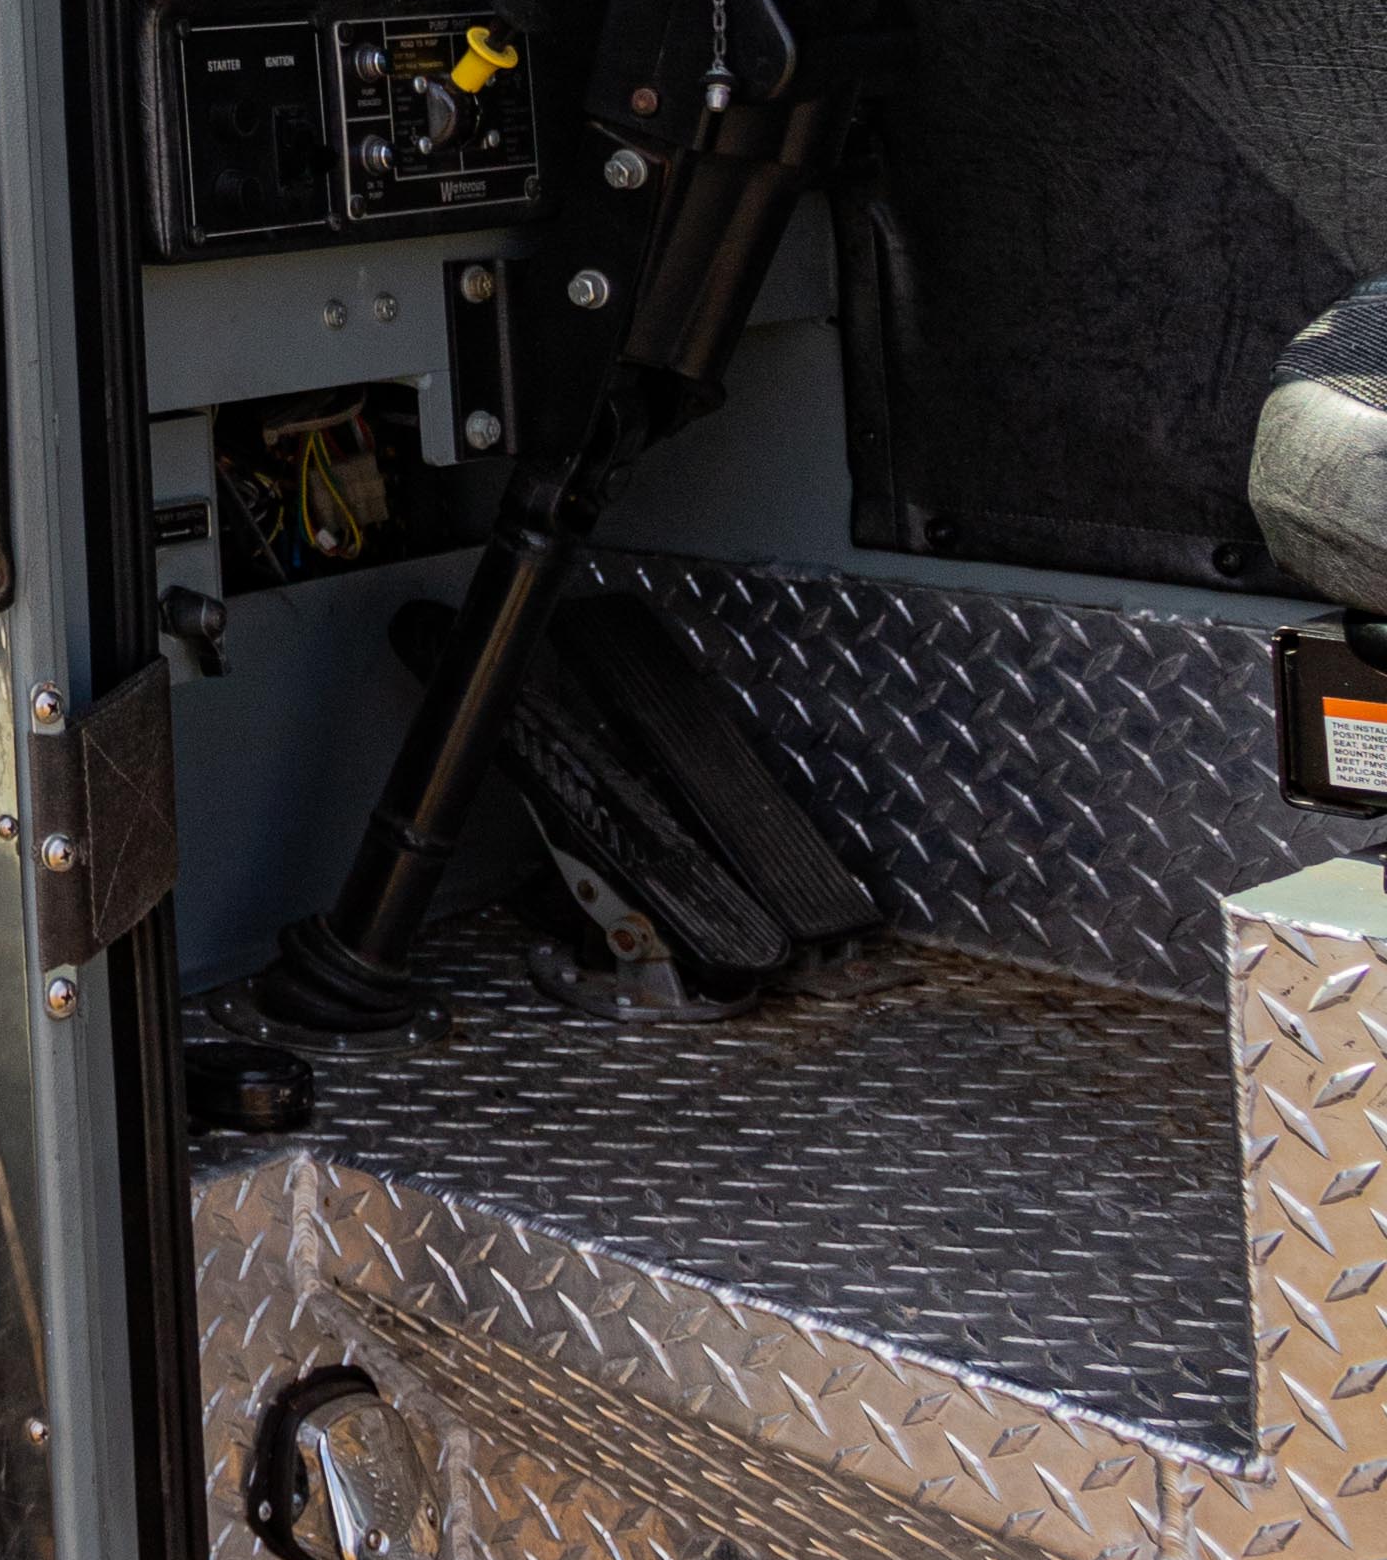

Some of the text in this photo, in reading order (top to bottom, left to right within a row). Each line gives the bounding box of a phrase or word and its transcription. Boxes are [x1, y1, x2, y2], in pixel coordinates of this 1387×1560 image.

[207, 58, 241, 72] STARTER
[264, 55, 295, 68] IGNITION
[440, 180, 486, 203] Waterous
[1332, 721, 1349, 730] THE
[1335, 748, 1385, 760] MOUNTING
[1336, 757, 1359, 765] MEET
[1337, 775, 1370, 784] INJURY
